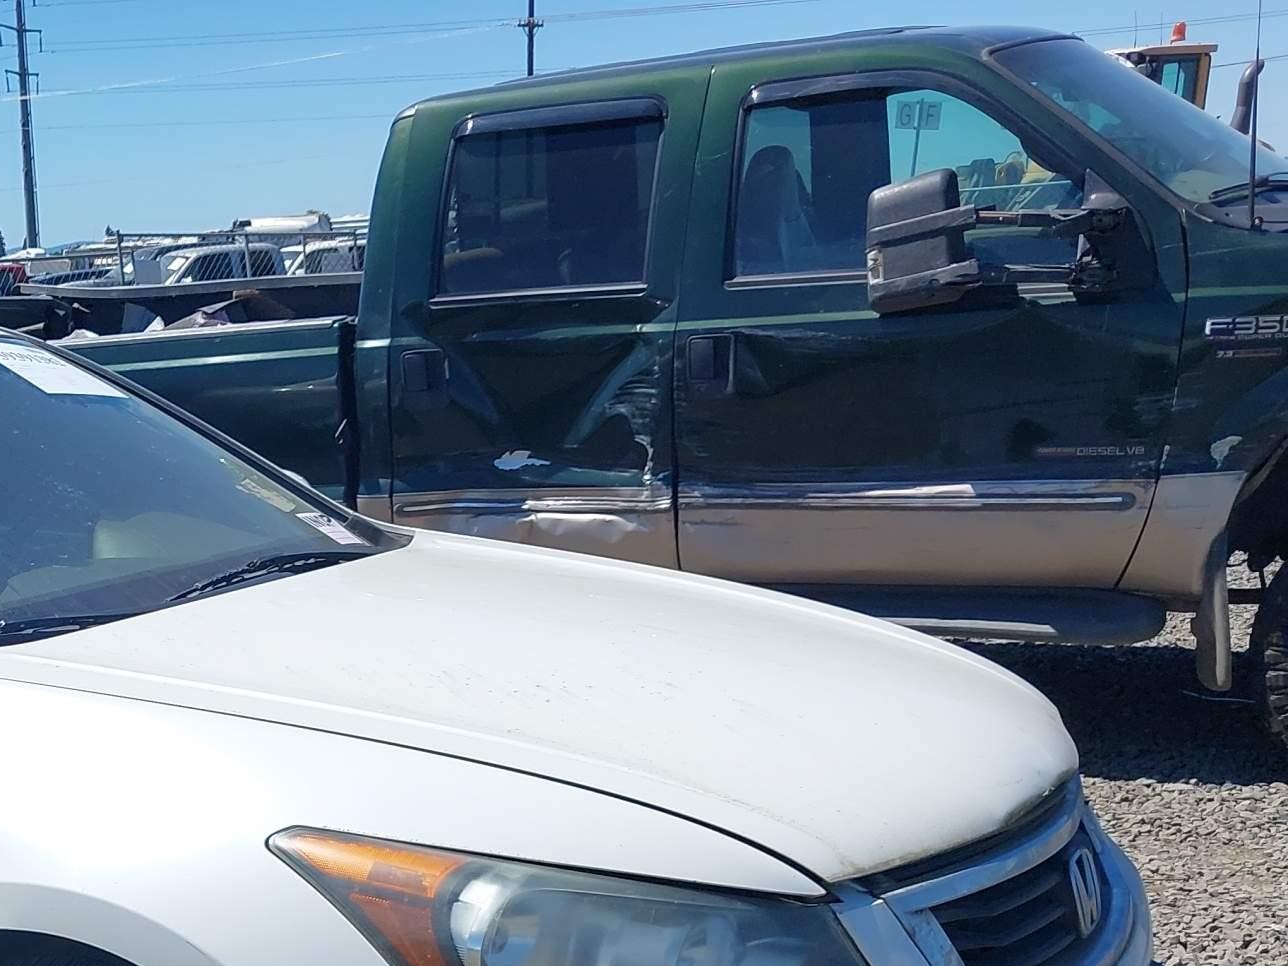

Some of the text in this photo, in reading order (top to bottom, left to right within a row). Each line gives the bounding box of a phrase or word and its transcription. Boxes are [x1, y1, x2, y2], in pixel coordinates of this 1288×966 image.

[900, 103, 912, 126] G
[925, 104, 937, 127] F
[1076, 446, 1125, 456] DIESEL
